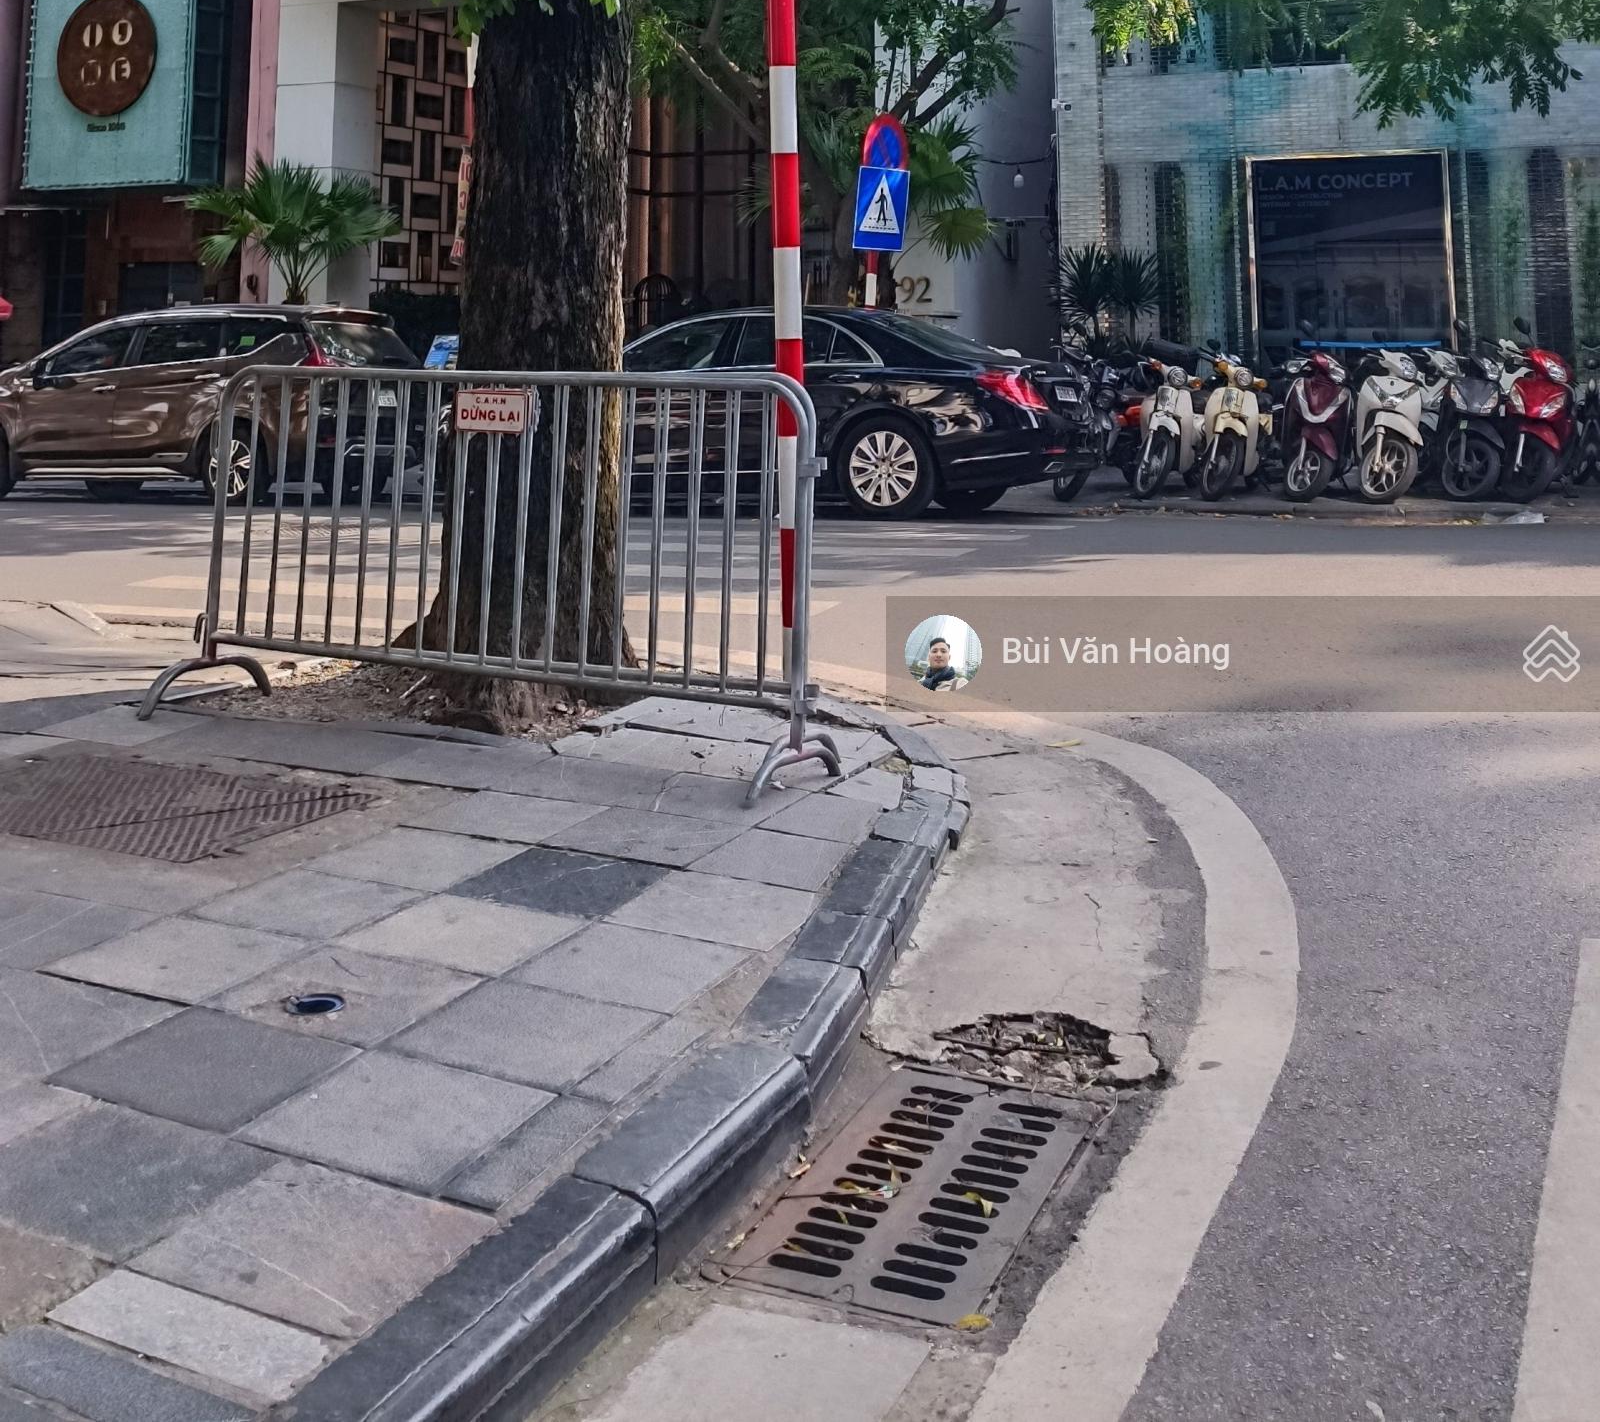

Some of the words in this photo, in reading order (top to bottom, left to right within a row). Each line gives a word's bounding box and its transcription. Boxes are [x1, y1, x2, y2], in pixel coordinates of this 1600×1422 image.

[1258, 176, 1311, 191] L.A.M
[1317, 172, 1413, 190] CONCEPT
[900, 276, 933, 304] 92
[499, 410, 520, 425] LẠI
